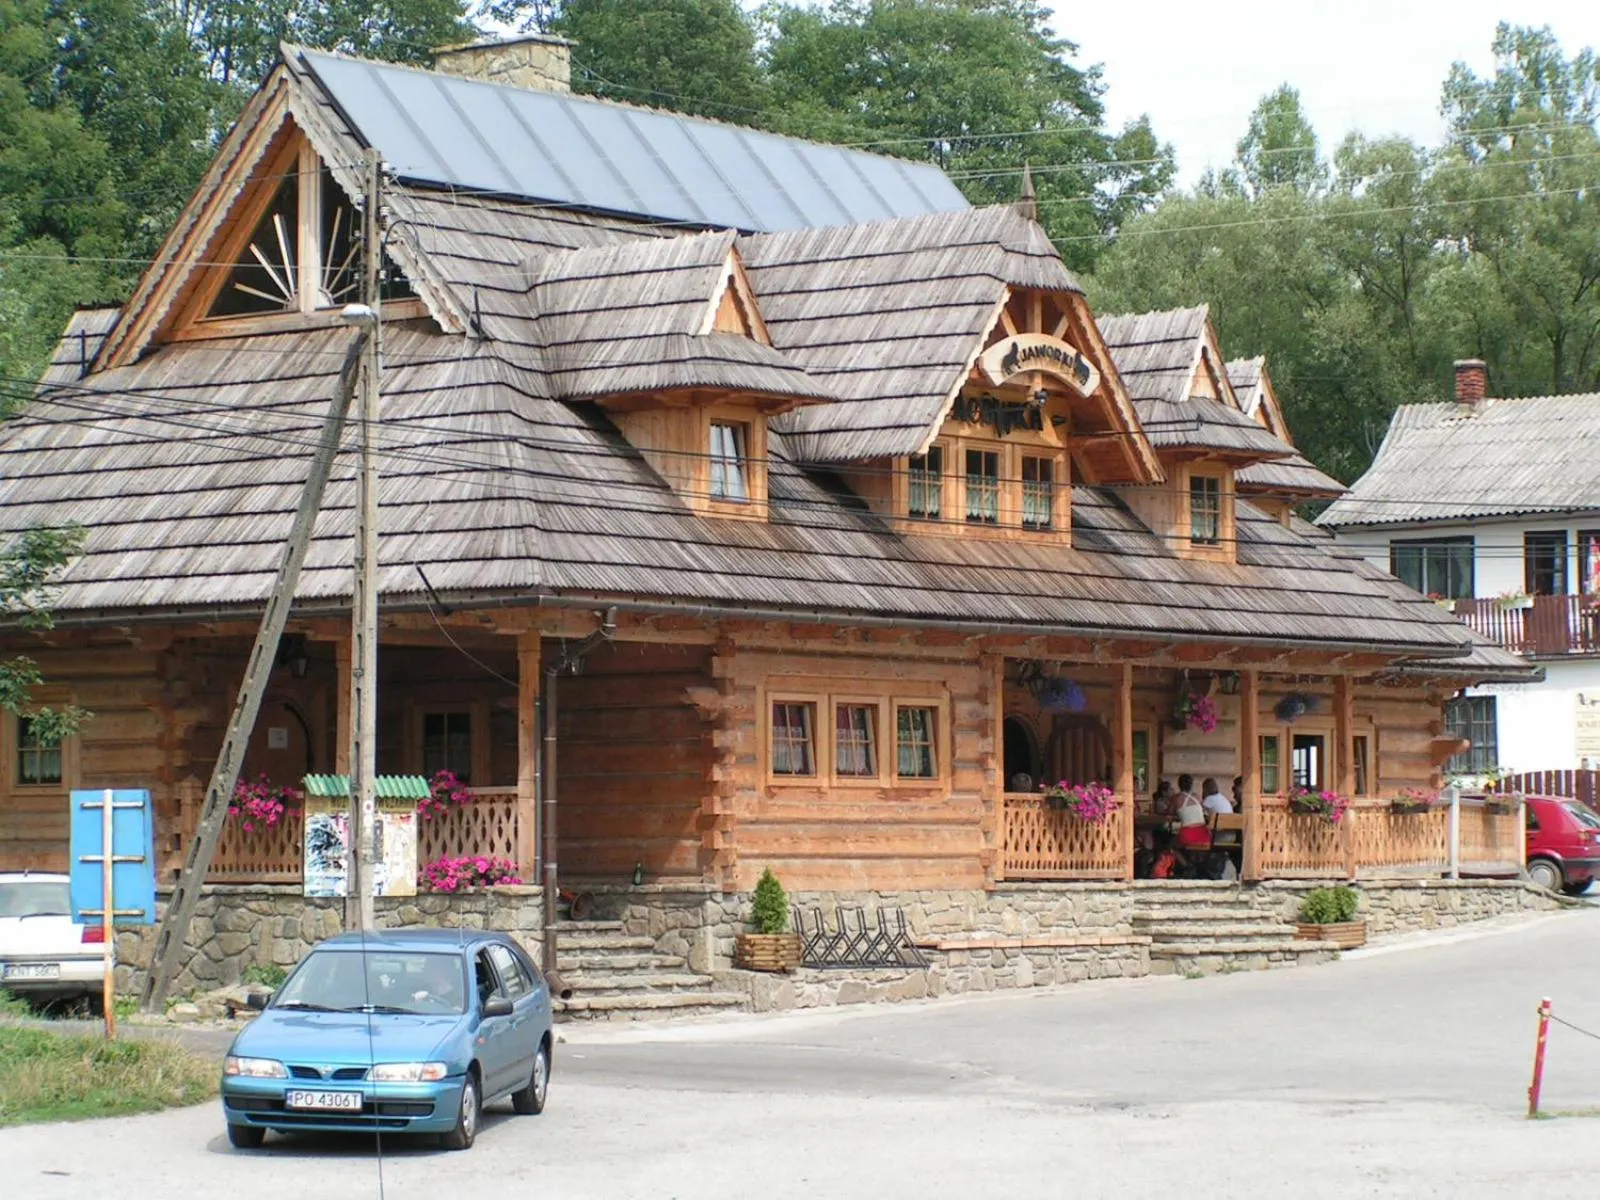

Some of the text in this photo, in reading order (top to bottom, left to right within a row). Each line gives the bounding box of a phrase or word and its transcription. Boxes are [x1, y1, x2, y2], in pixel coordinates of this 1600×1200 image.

[1020, 344, 1073, 369] JAWORKI
[294, 1092, 359, 1107] PO 4306T
